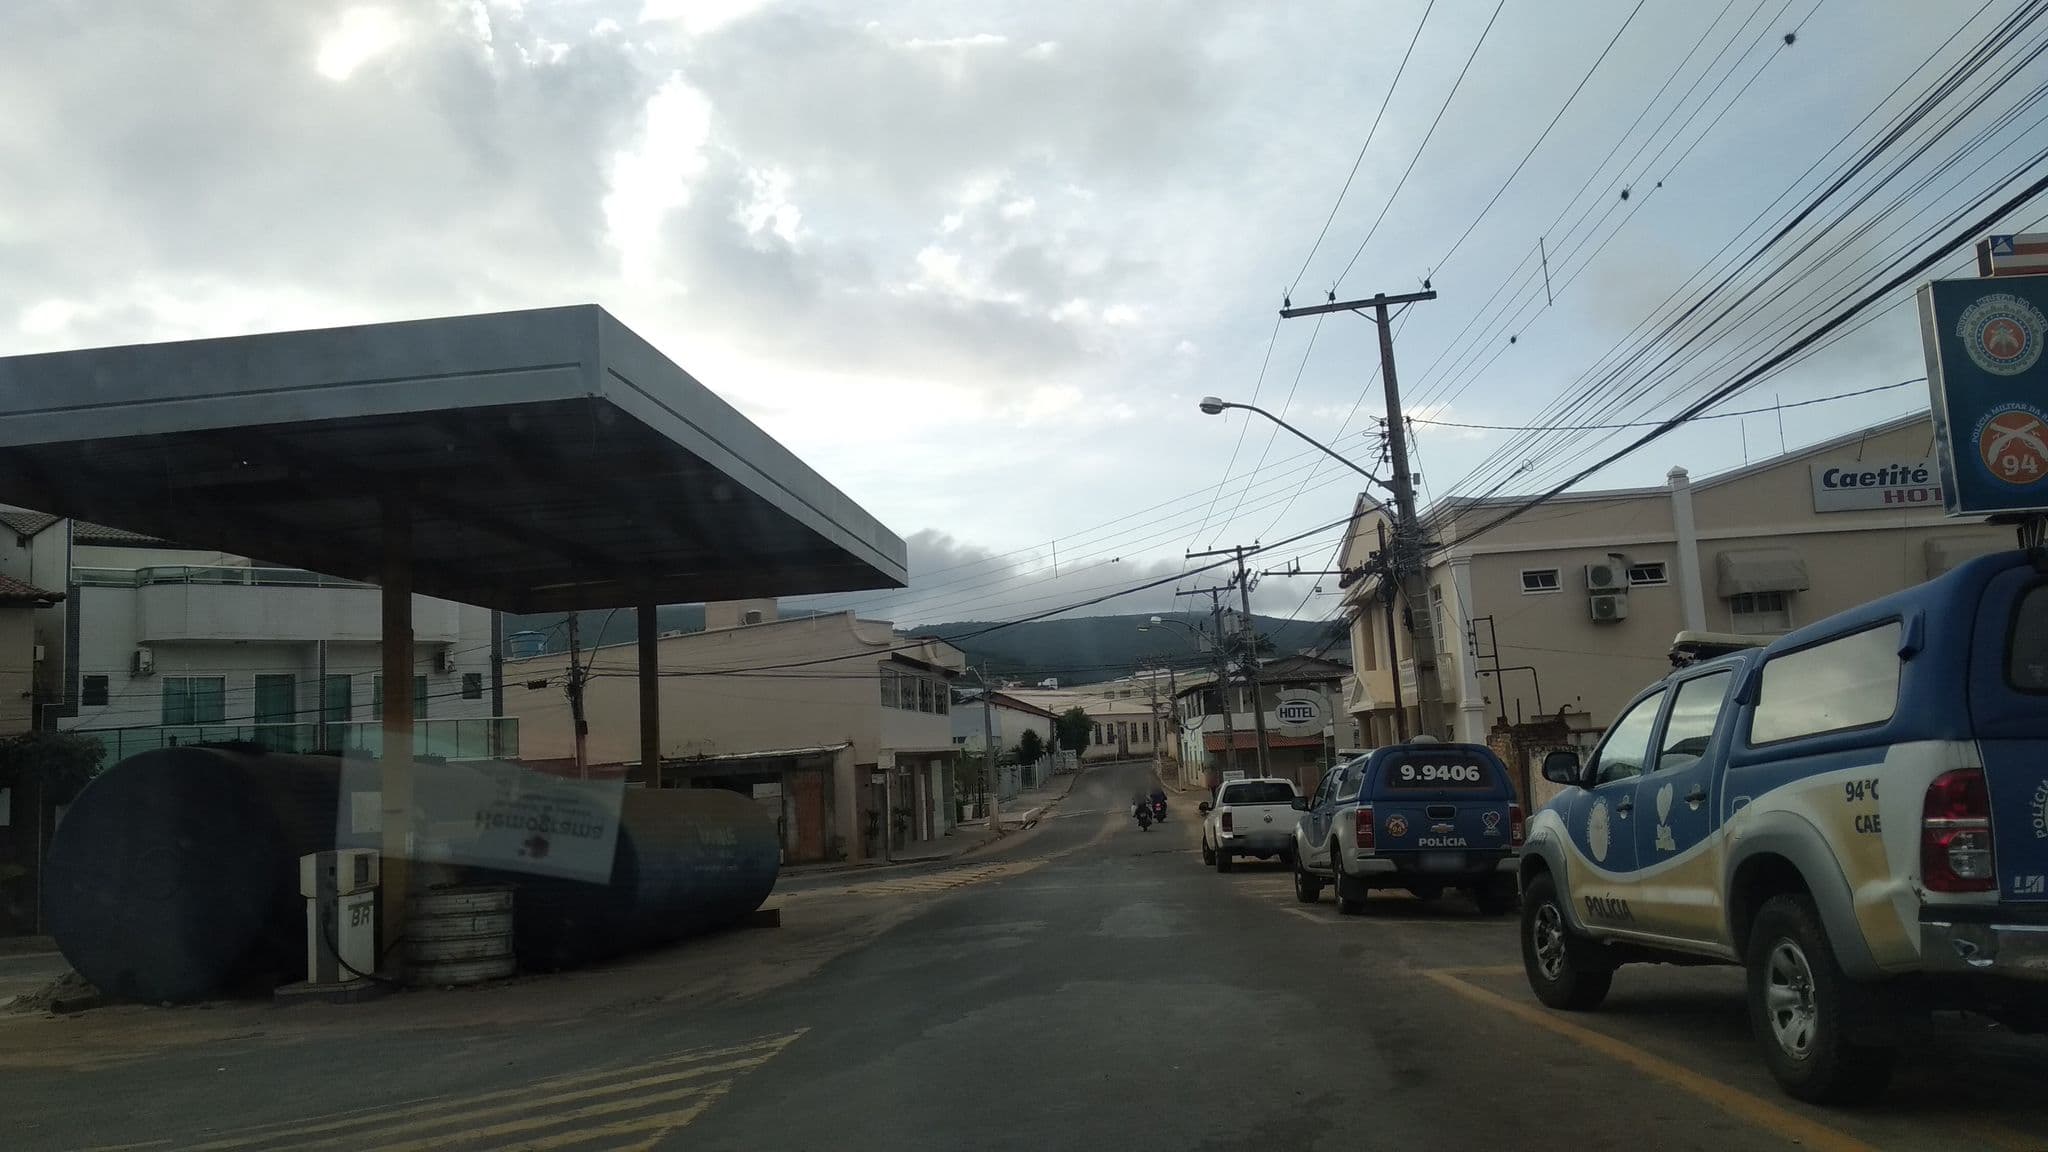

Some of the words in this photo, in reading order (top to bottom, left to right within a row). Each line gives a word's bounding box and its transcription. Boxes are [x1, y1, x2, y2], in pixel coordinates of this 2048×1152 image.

[1991, 402, 2027, 415] MILITAR
[2028, 405, 2041, 416] DA
[2002, 454, 2038, 476] 94
[1823, 463, 1929, 488] Caetité
[1279, 706, 1316, 718] HOTEL
[1400, 764, 1481, 781] 9.9406
[1855, 814, 1882, 834] CAE
[1418, 836, 1468, 847] POLÍCIA
[1584, 892, 1635, 922] POLÍCIA
